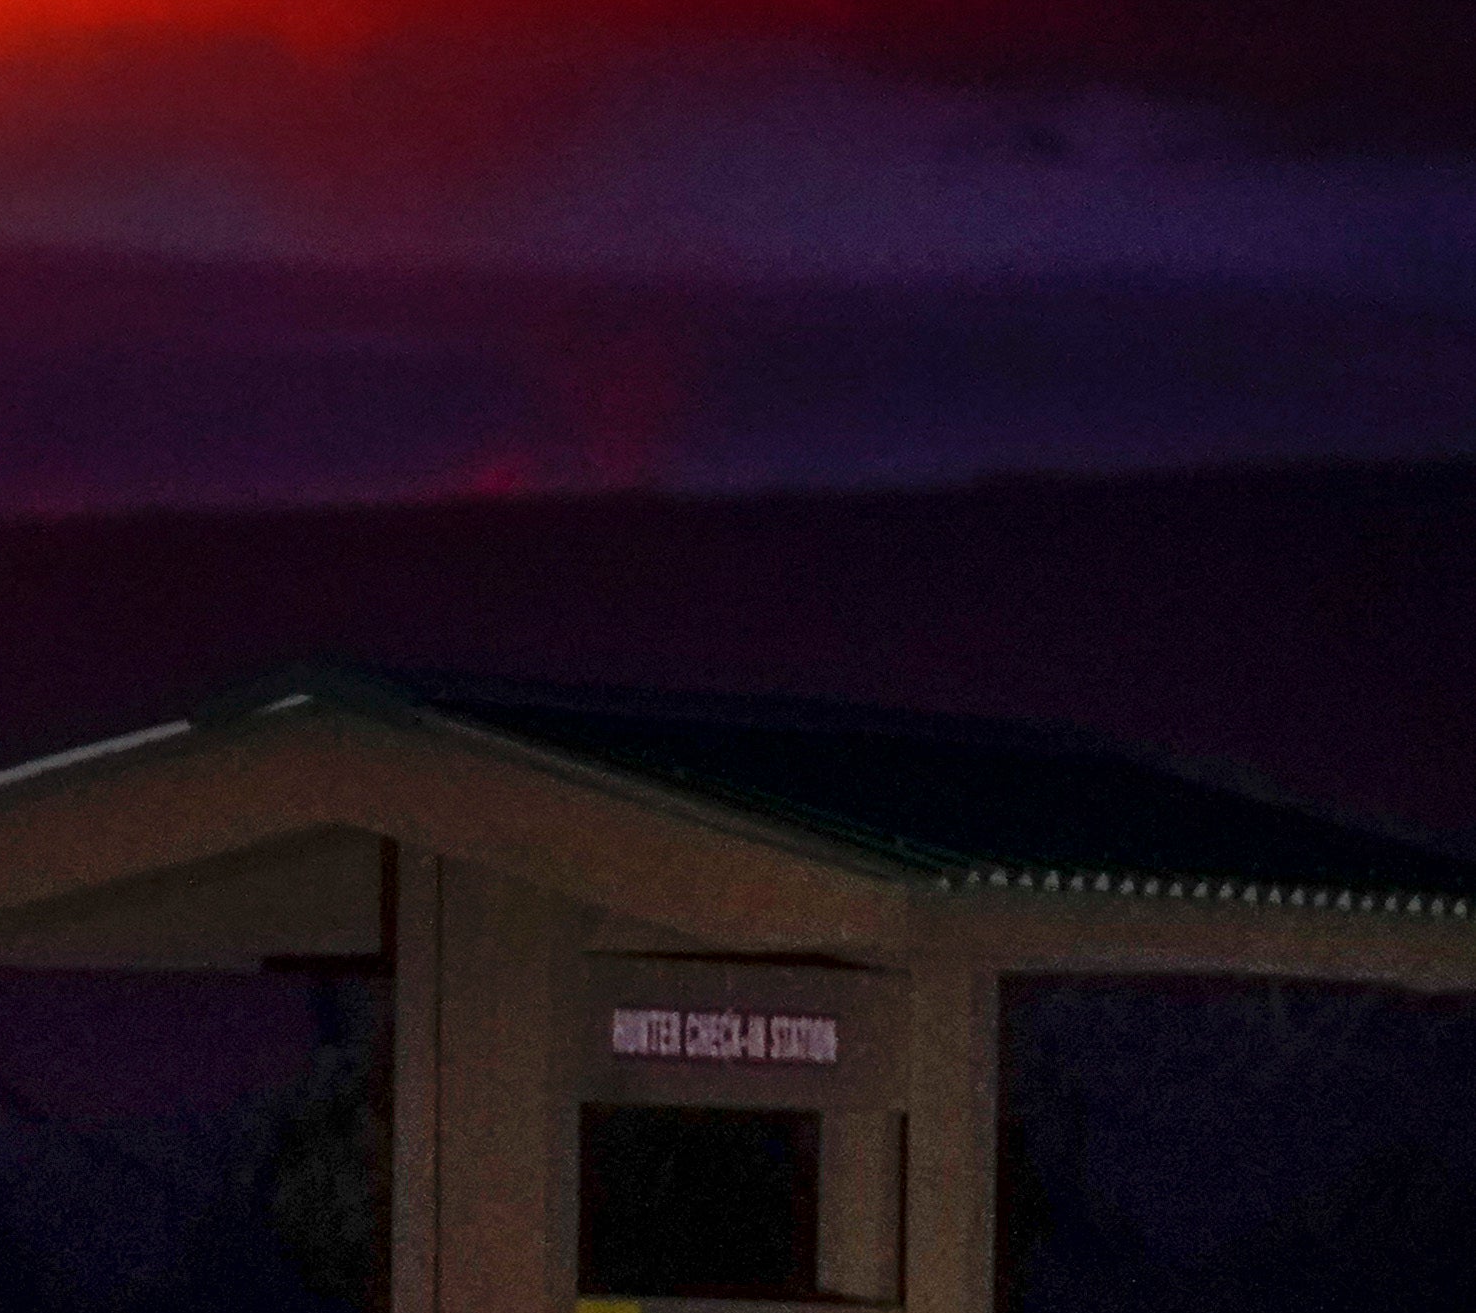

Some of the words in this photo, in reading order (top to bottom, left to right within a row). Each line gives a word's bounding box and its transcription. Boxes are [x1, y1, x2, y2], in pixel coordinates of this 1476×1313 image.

[613, 1008, 681, 1056] HUNTER
[685, 1011, 766, 1058] CHECK-IN
[770, 1015, 838, 1063] STATION
